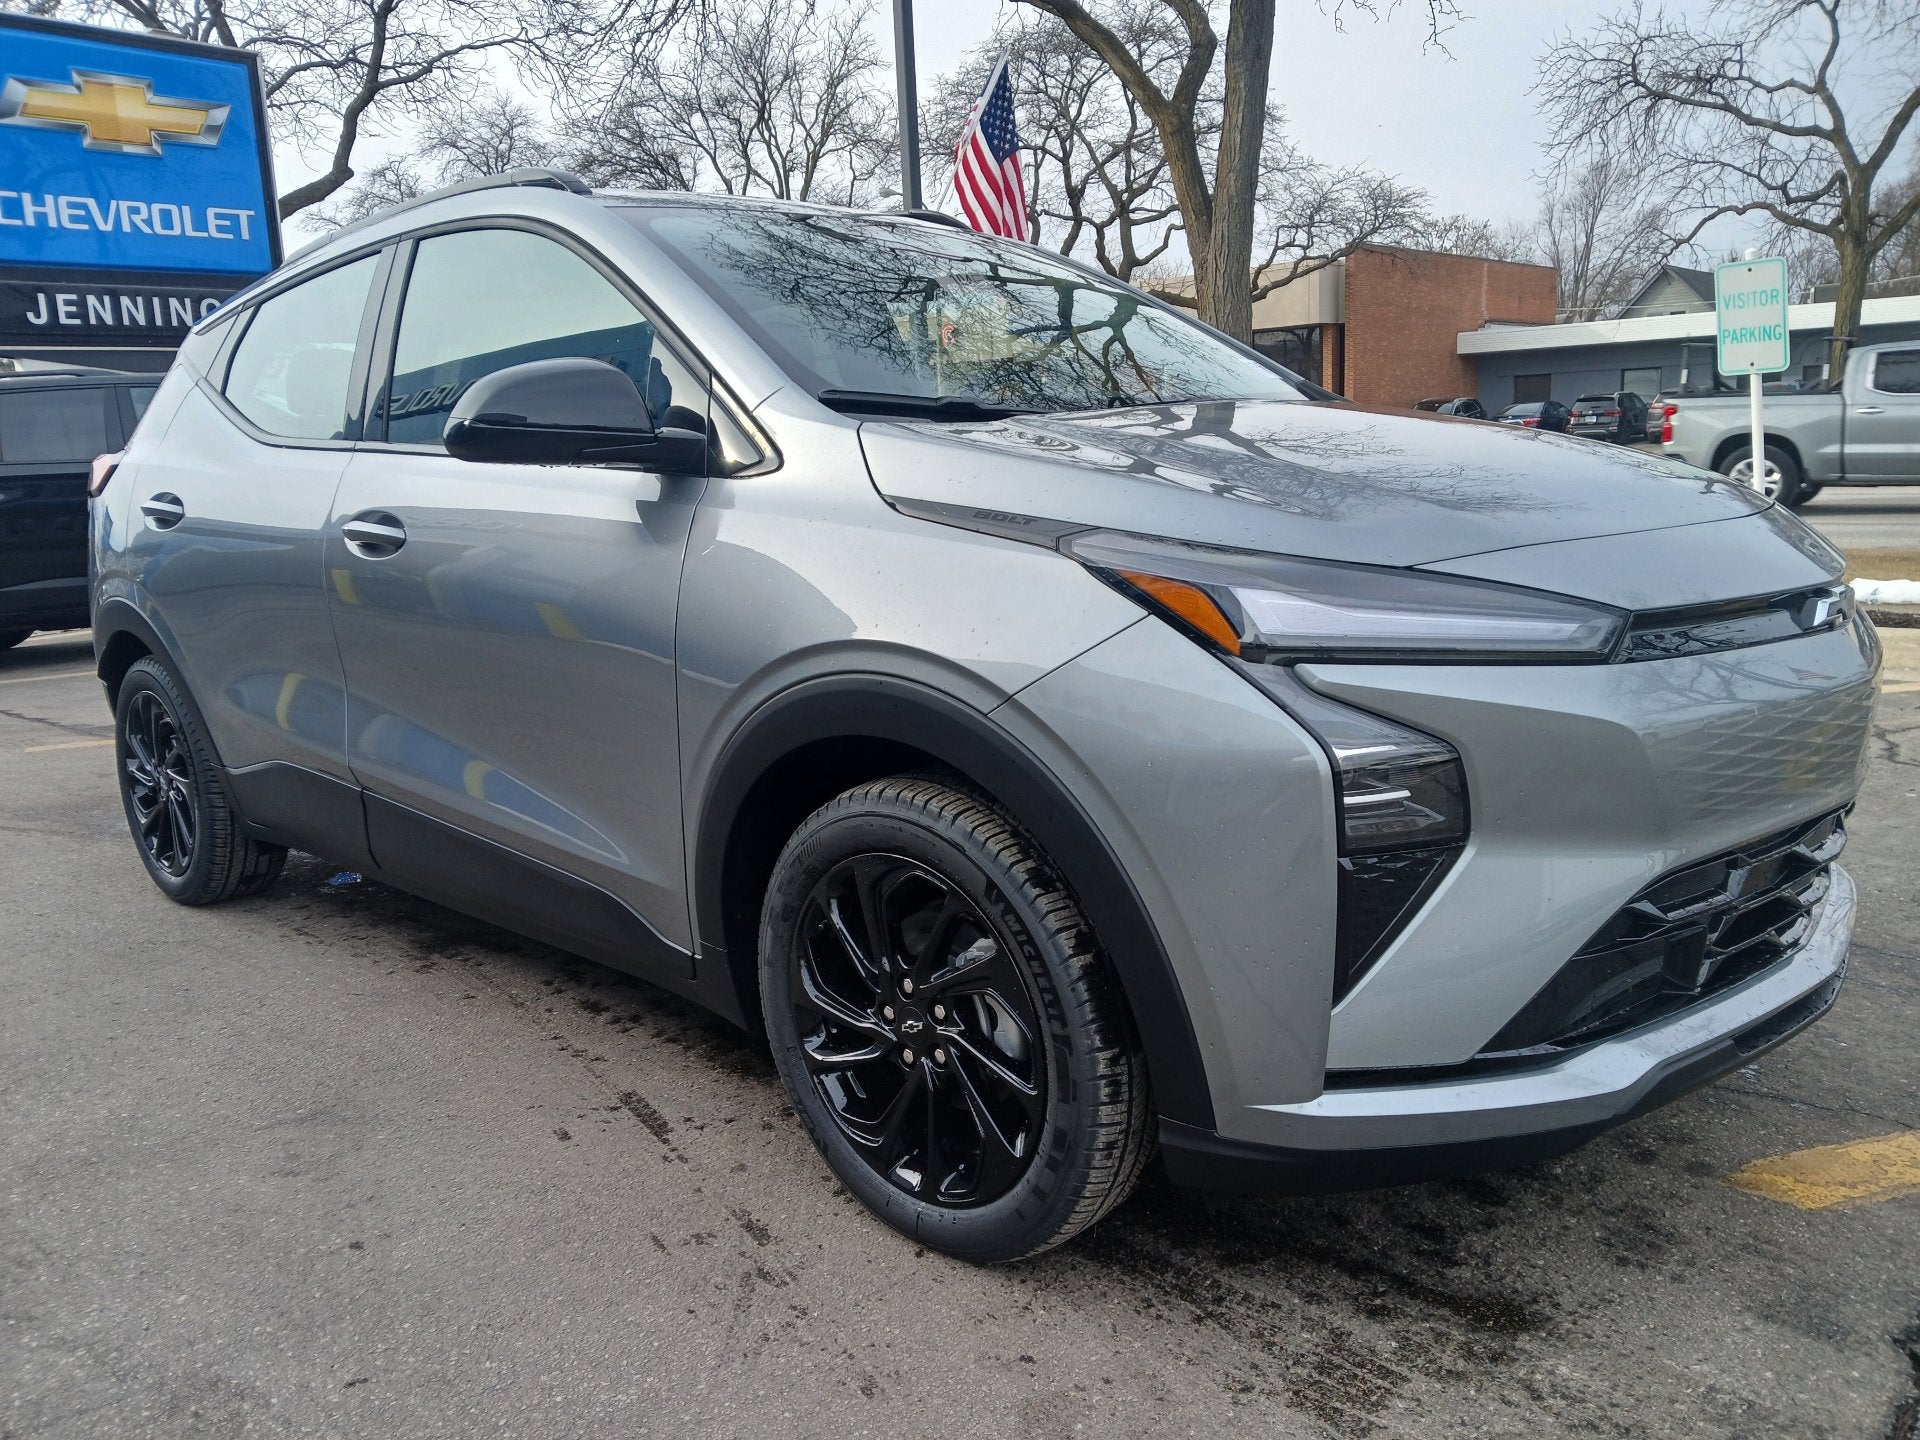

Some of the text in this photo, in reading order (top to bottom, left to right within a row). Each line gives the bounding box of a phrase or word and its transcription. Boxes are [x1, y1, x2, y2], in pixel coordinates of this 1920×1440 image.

[0, 190, 255, 240] CHEVROLET
[1722, 288, 1780, 310] VISITOR
[1722, 324, 1782, 345] PARKING
[972, 510, 1038, 526] BOLT
